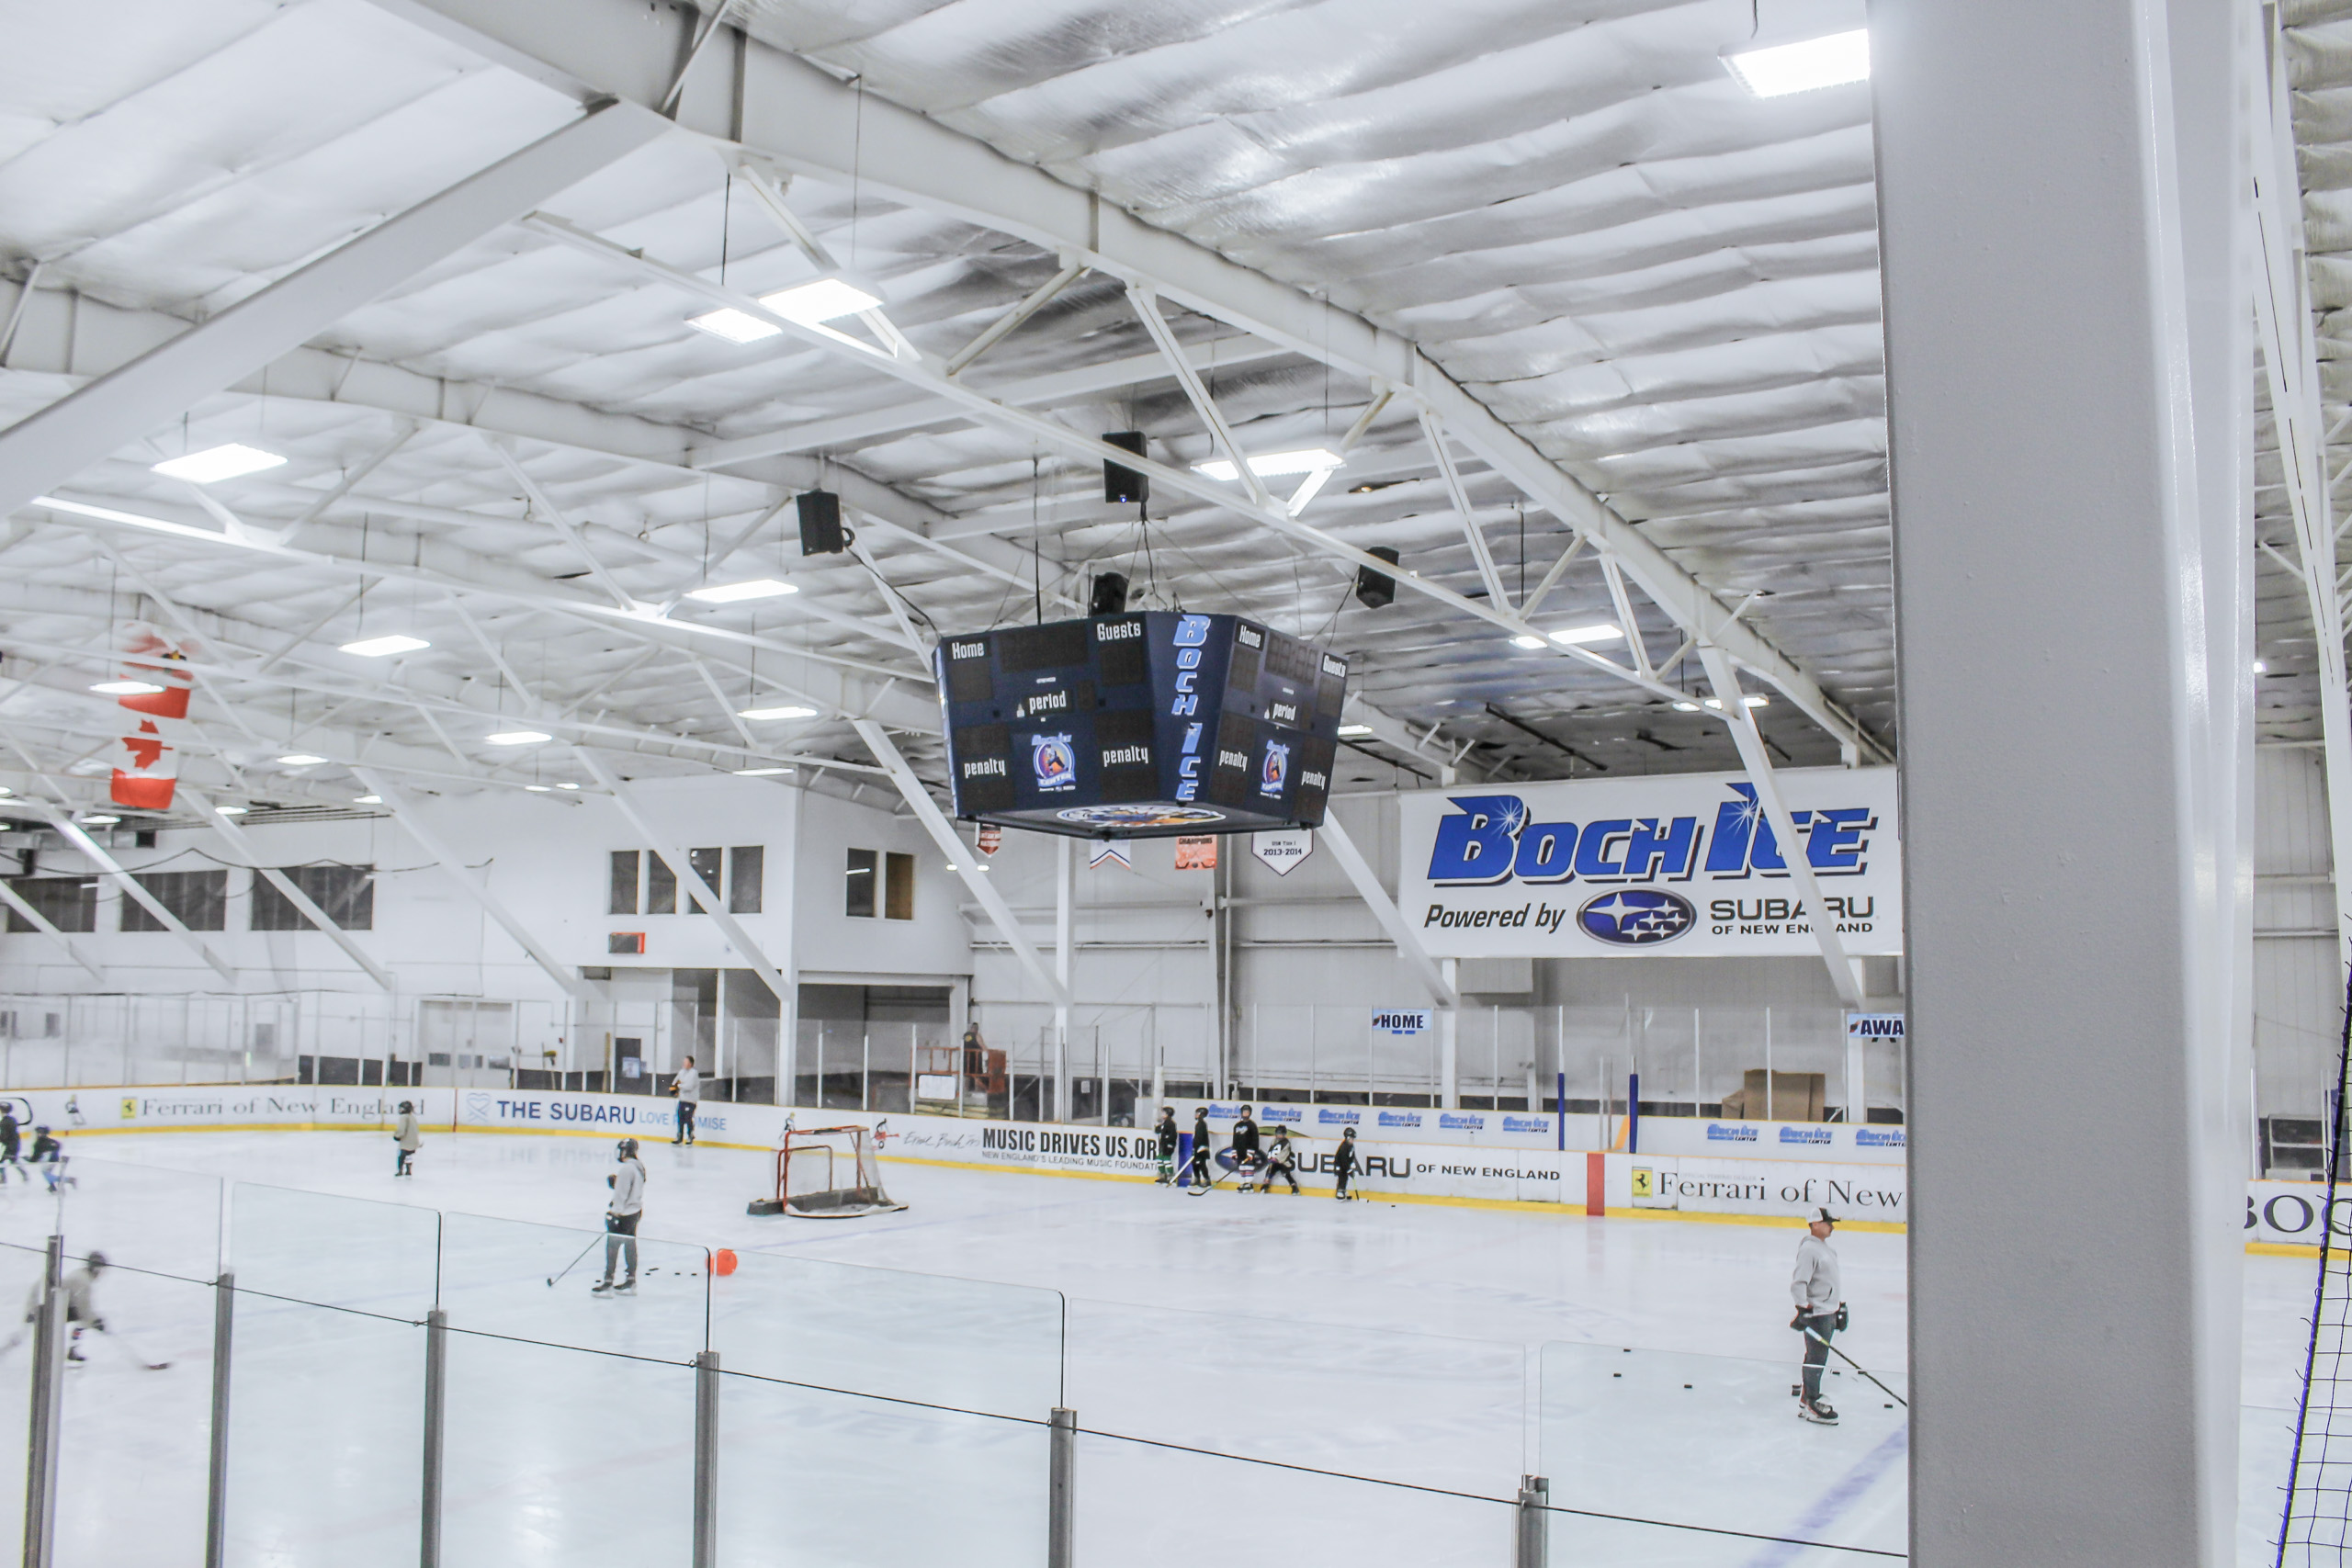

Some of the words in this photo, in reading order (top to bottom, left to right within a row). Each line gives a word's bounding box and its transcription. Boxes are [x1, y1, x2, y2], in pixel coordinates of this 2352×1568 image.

[1097, 621, 1141, 641] Guests
[1239, 625, 1261, 649] Home
[952, 642, 984, 660] Home
[1029, 690, 1067, 715] period
[1272, 703, 1296, 721] period
[1102, 745, 1148, 767] penalty
[1218, 749, 1248, 773] penalty
[964, 758, 1006, 779] penalty
[1301, 771, 1326, 790] penalty
[1427, 795, 1705, 887] BOCH
[1263, 848, 1302, 856] 2013-2014
[1424, 903, 1531, 929] Powered
[1535, 902, 1566, 933] by
[1712, 925, 1734, 935] OF
[1740, 924, 1780, 935] NEW
[1786, 922, 1873, 934] ENAND
[1381, 1014, 1424, 1029] HOME
[1860, 1020, 1904, 1035] AWA
[142, 1099, 223, 1116] Ferrari
[232, 1098, 257, 1115] of
[266, 1097, 320, 1114] New
[331, 1098, 424, 1119] Englad
[497, 1100, 541, 1119] THE
[550, 1102, 636, 1124] SUBARU
[639, 1111, 669, 1125] LOVE
[673, 1113, 727, 1131] PMISE
[983, 1127, 1035, 1152] MUSIC
[1040, 1131, 1100, 1156] DRIVES
[1105, 1135, 1159, 1160] US.OR
[982, 1150, 1000, 1160] NEW
[1001, 1151, 1046, 1163] ENGLAND'S
[1048, 1154, 1084, 1167] LEADING
[1086, 1158, 1113, 1168] MUSIC
[1114, 1160, 1158, 1171] FOUNDATI
[1417, 1164, 1436, 1174] OF
[1442, 1165, 1476, 1176] NEW
[1482, 1168, 1560, 1180] ENGLAND
[1657, 1171, 1766, 1201] Ferrari
[1781, 1178, 1816, 1202] of
[1826, 1179, 1905, 1208] New
